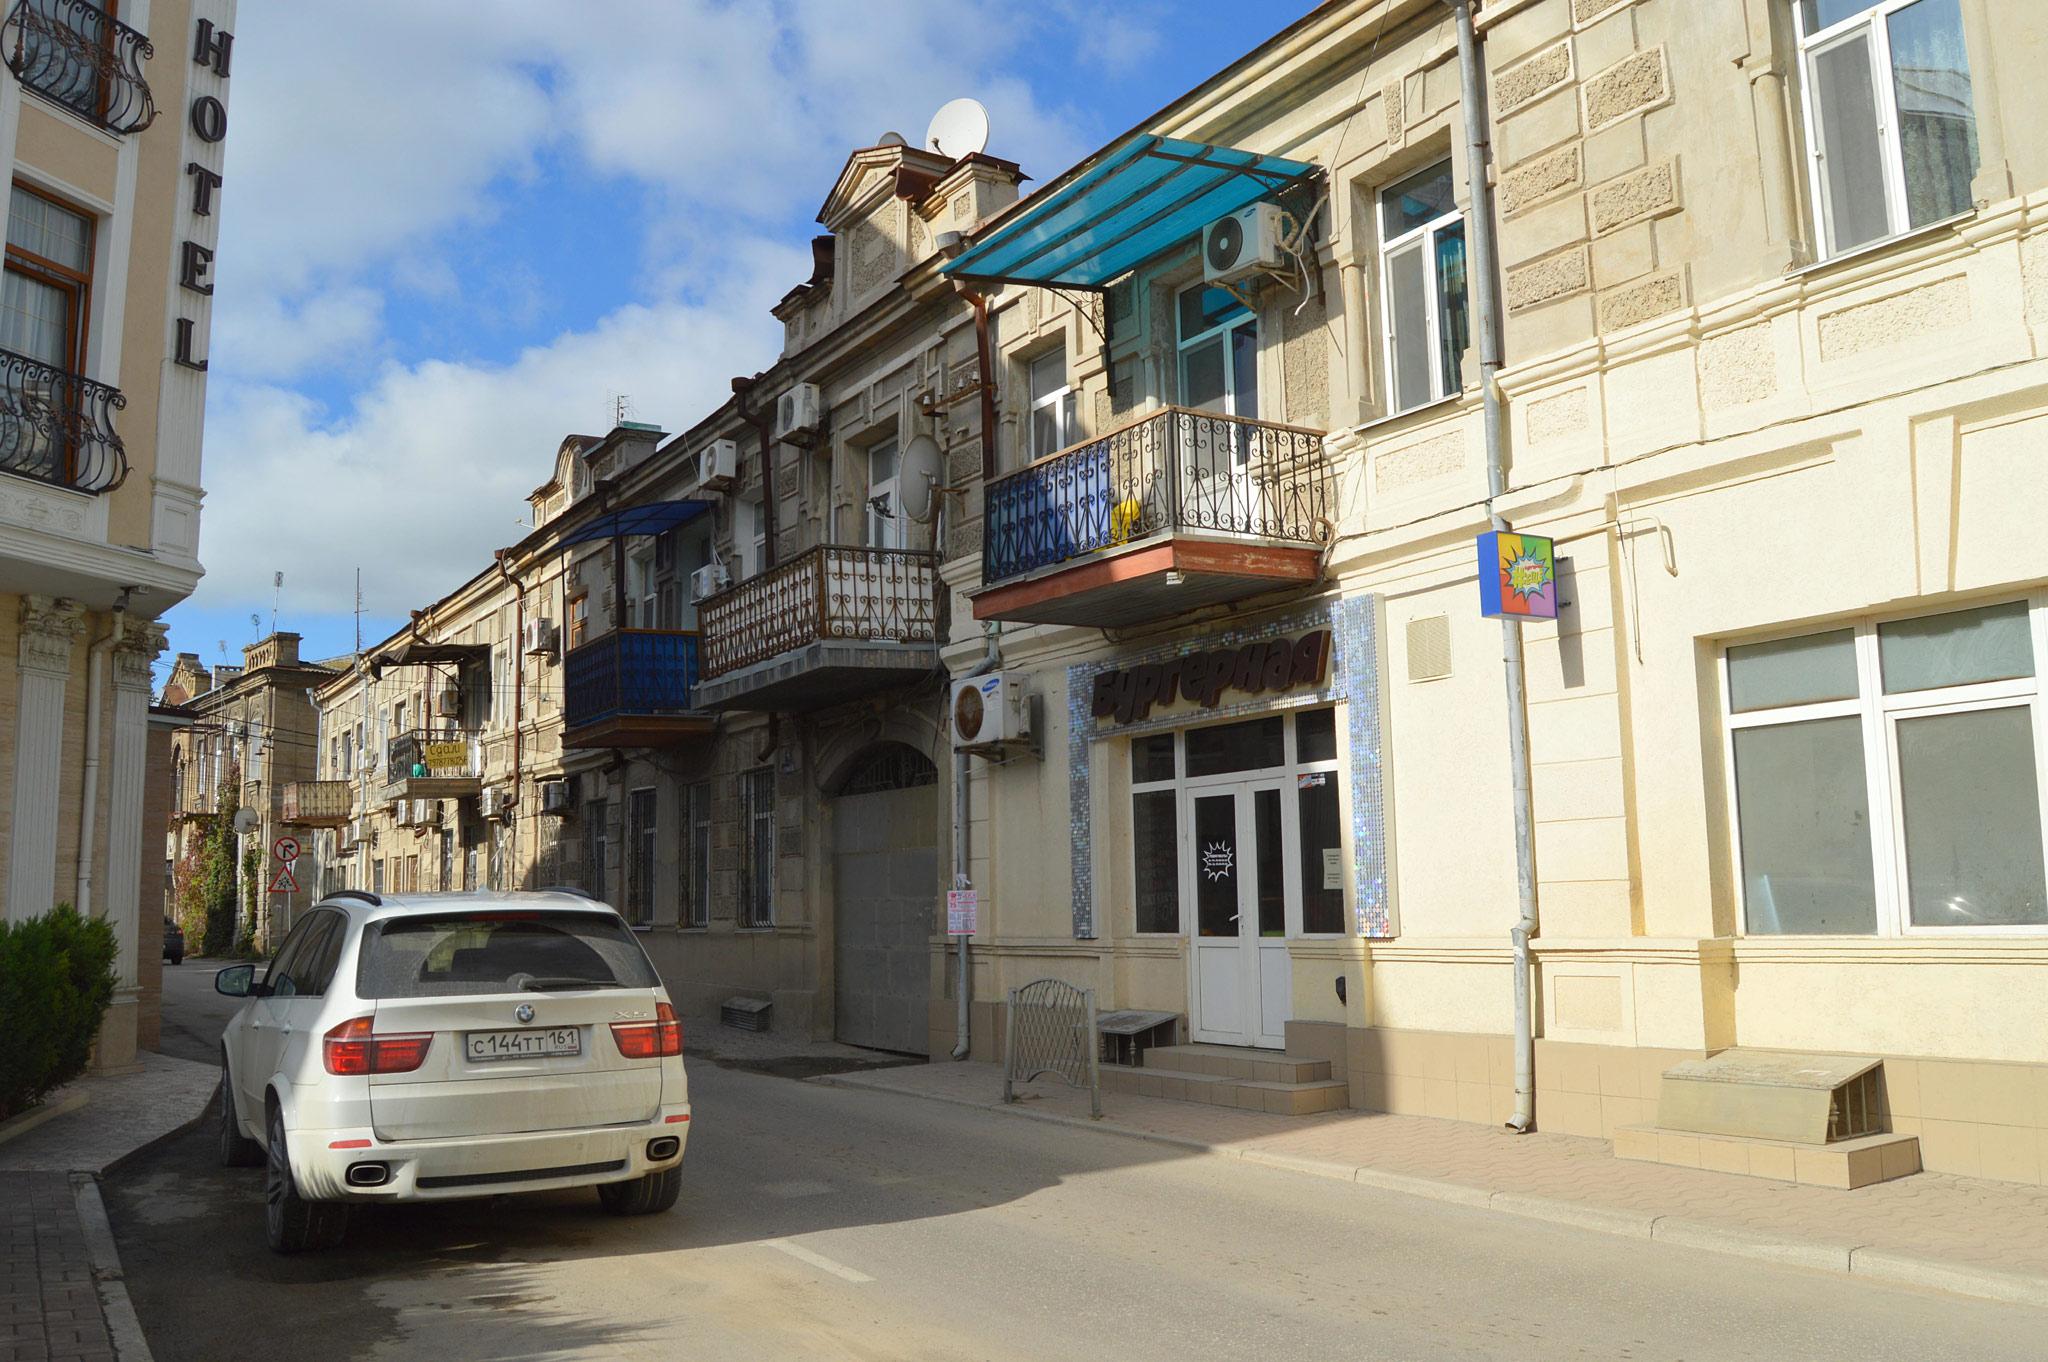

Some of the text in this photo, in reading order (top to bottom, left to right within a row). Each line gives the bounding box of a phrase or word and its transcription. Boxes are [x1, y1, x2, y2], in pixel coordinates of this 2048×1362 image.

[174, 17, 235, 372] HOTEL
[1091, 629, 1331, 725] Бургерная
[548, 1030, 575, 1045] 161
[614, 1010, 647, 1020] X5
